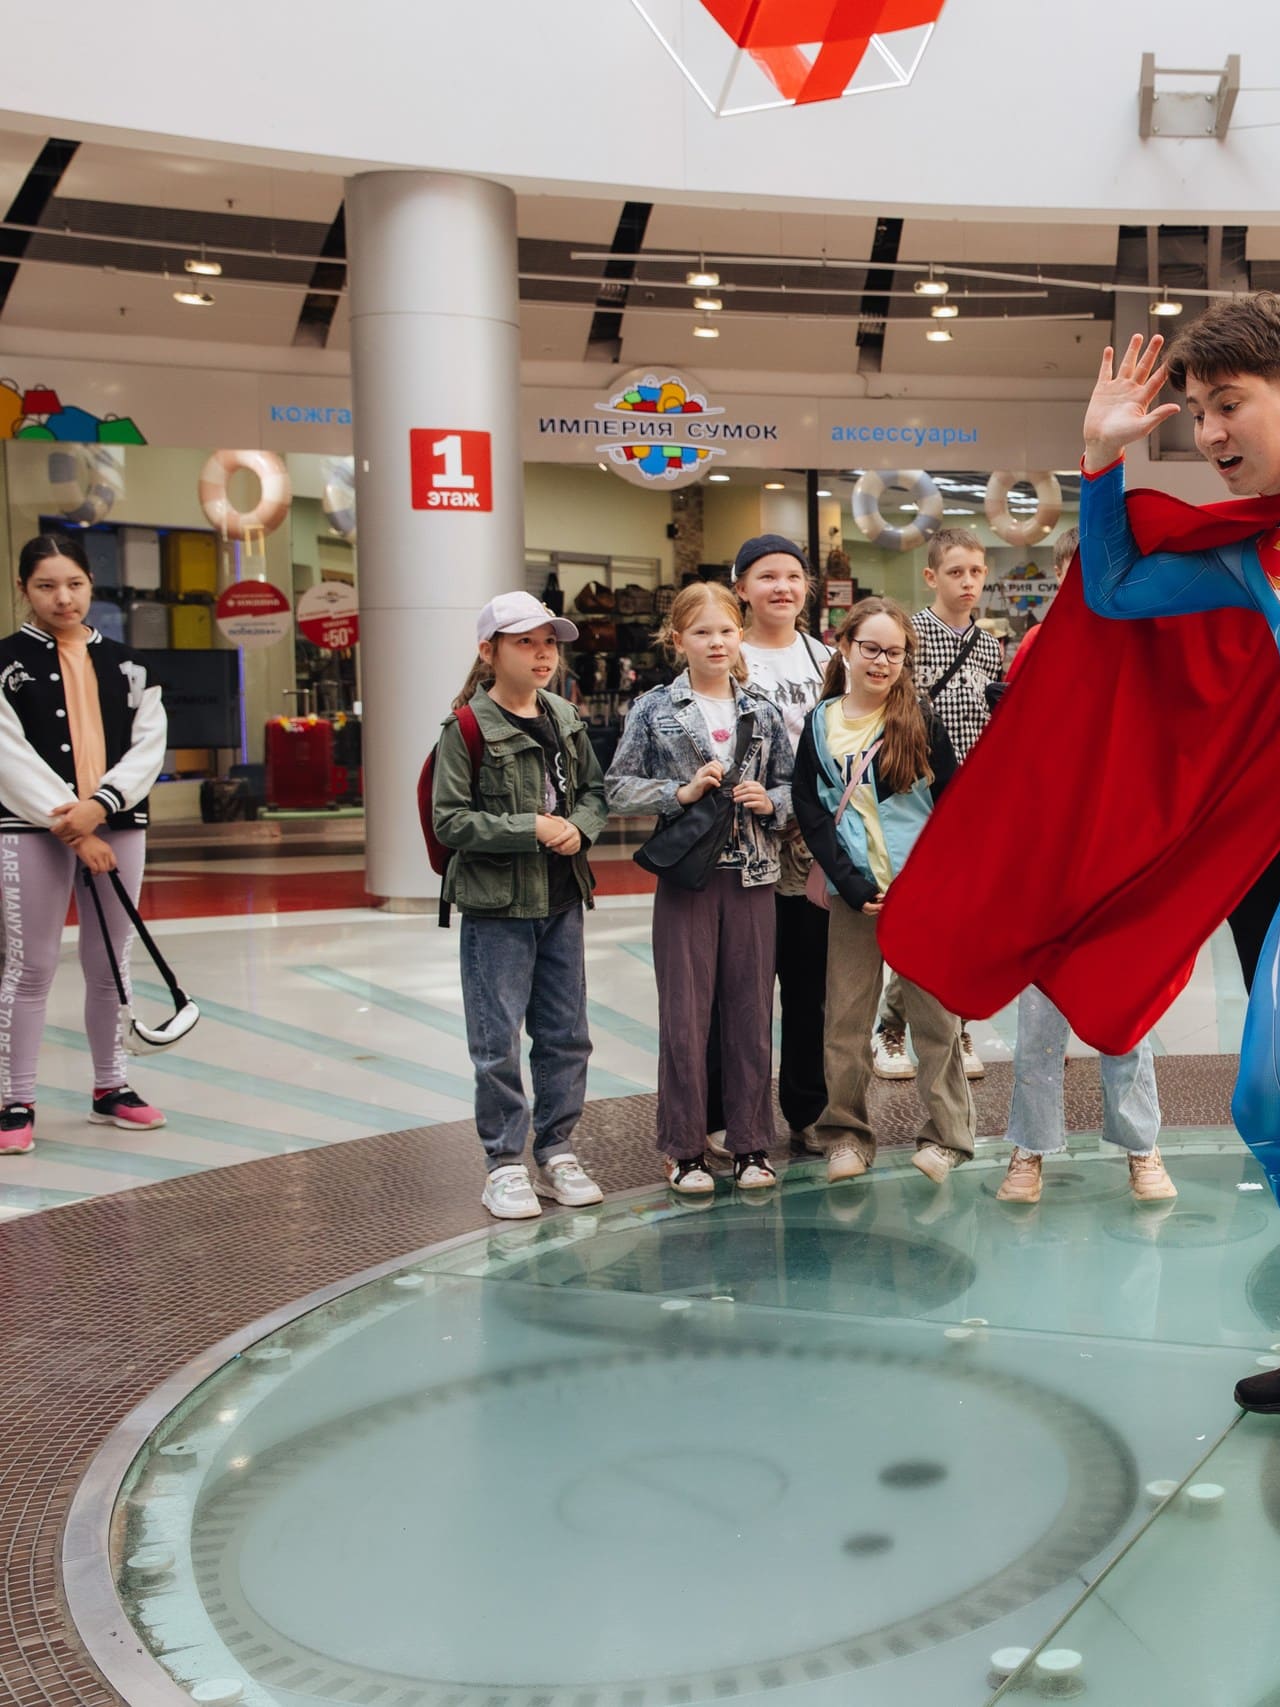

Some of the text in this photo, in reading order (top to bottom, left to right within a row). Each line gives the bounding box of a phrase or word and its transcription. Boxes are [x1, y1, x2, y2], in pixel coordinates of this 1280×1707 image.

[538, 418, 778, 440] ИМПЕРИЯ СУМОК
[831, 423, 978, 447] аксессуары
[432, 435, 474, 489] 1
[427, 491, 480, 507] этаж
[1, 847, 20, 882] ARE
[4, 887, 24, 935] MANY
